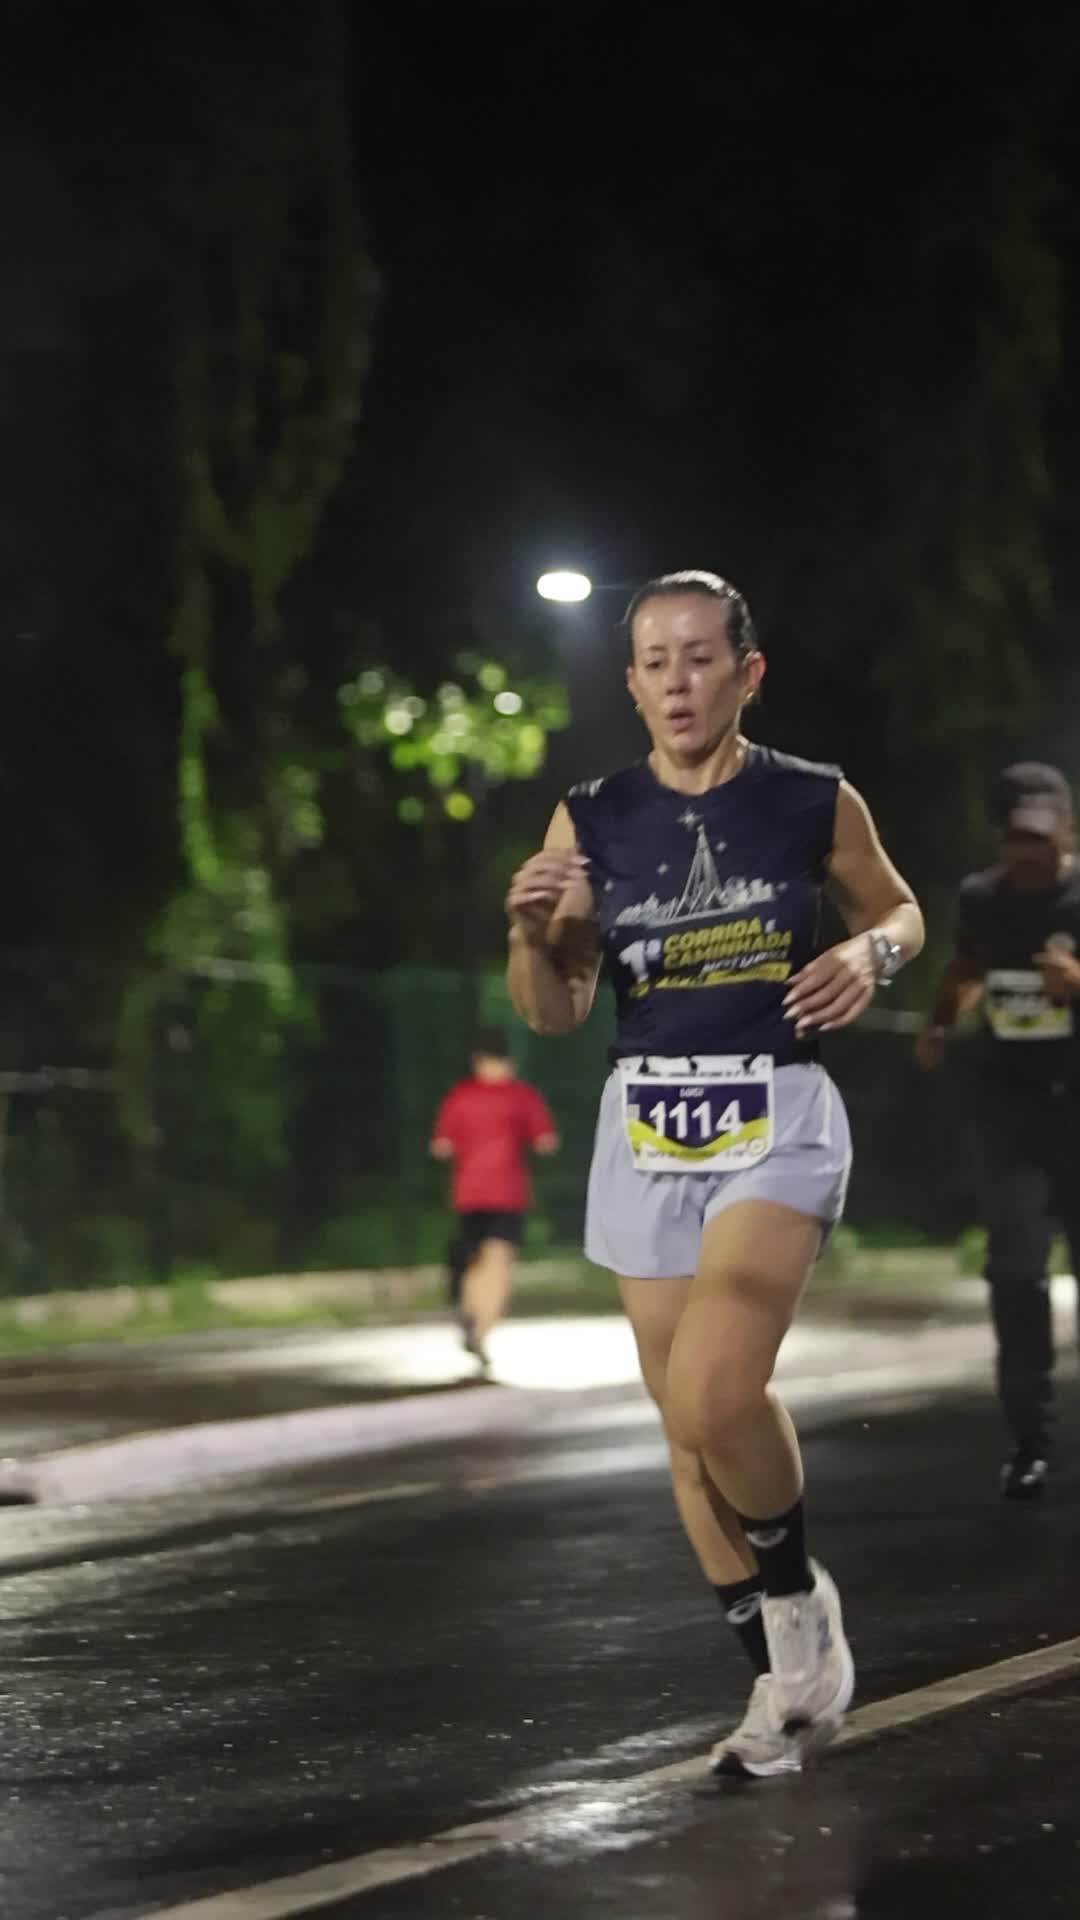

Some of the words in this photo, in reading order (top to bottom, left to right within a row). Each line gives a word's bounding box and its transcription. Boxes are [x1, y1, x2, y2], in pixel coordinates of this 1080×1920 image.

[663, 916, 762, 954] CORRIDA
[664, 931, 792, 970] CAMINHADA
[649, 1099, 744, 1139] 1114
